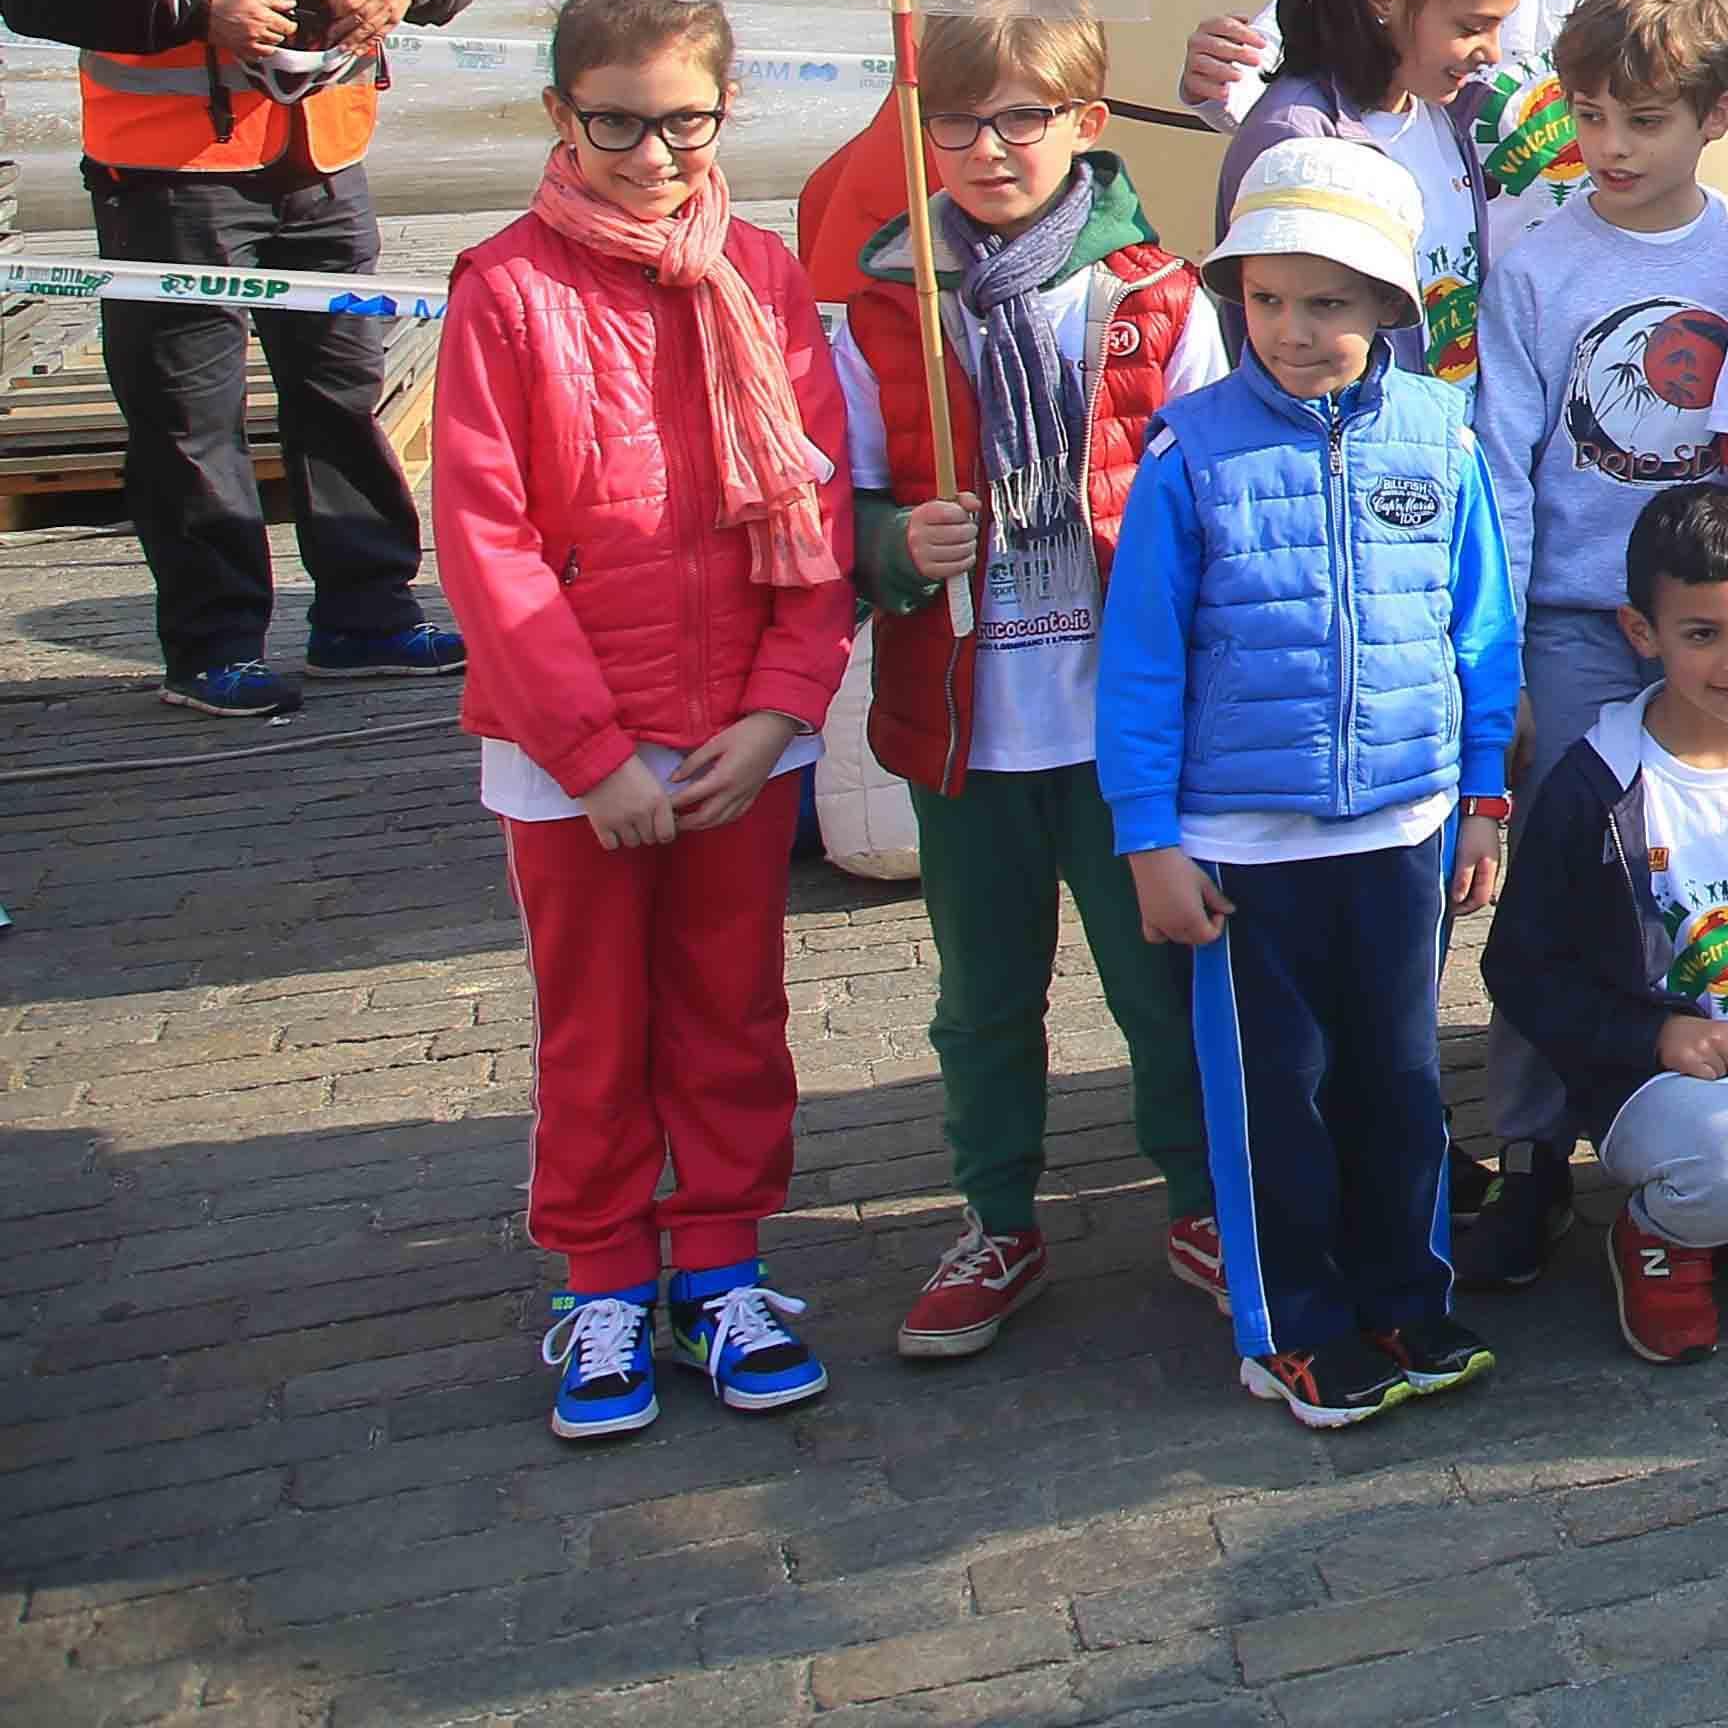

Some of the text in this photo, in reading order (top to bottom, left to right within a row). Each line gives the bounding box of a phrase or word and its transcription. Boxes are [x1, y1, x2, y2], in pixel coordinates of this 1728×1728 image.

[1500, 113, 1573, 174] VIVICITT
[201, 272, 290, 299] UISP
[1576, 441, 1662, 481] Dojo
